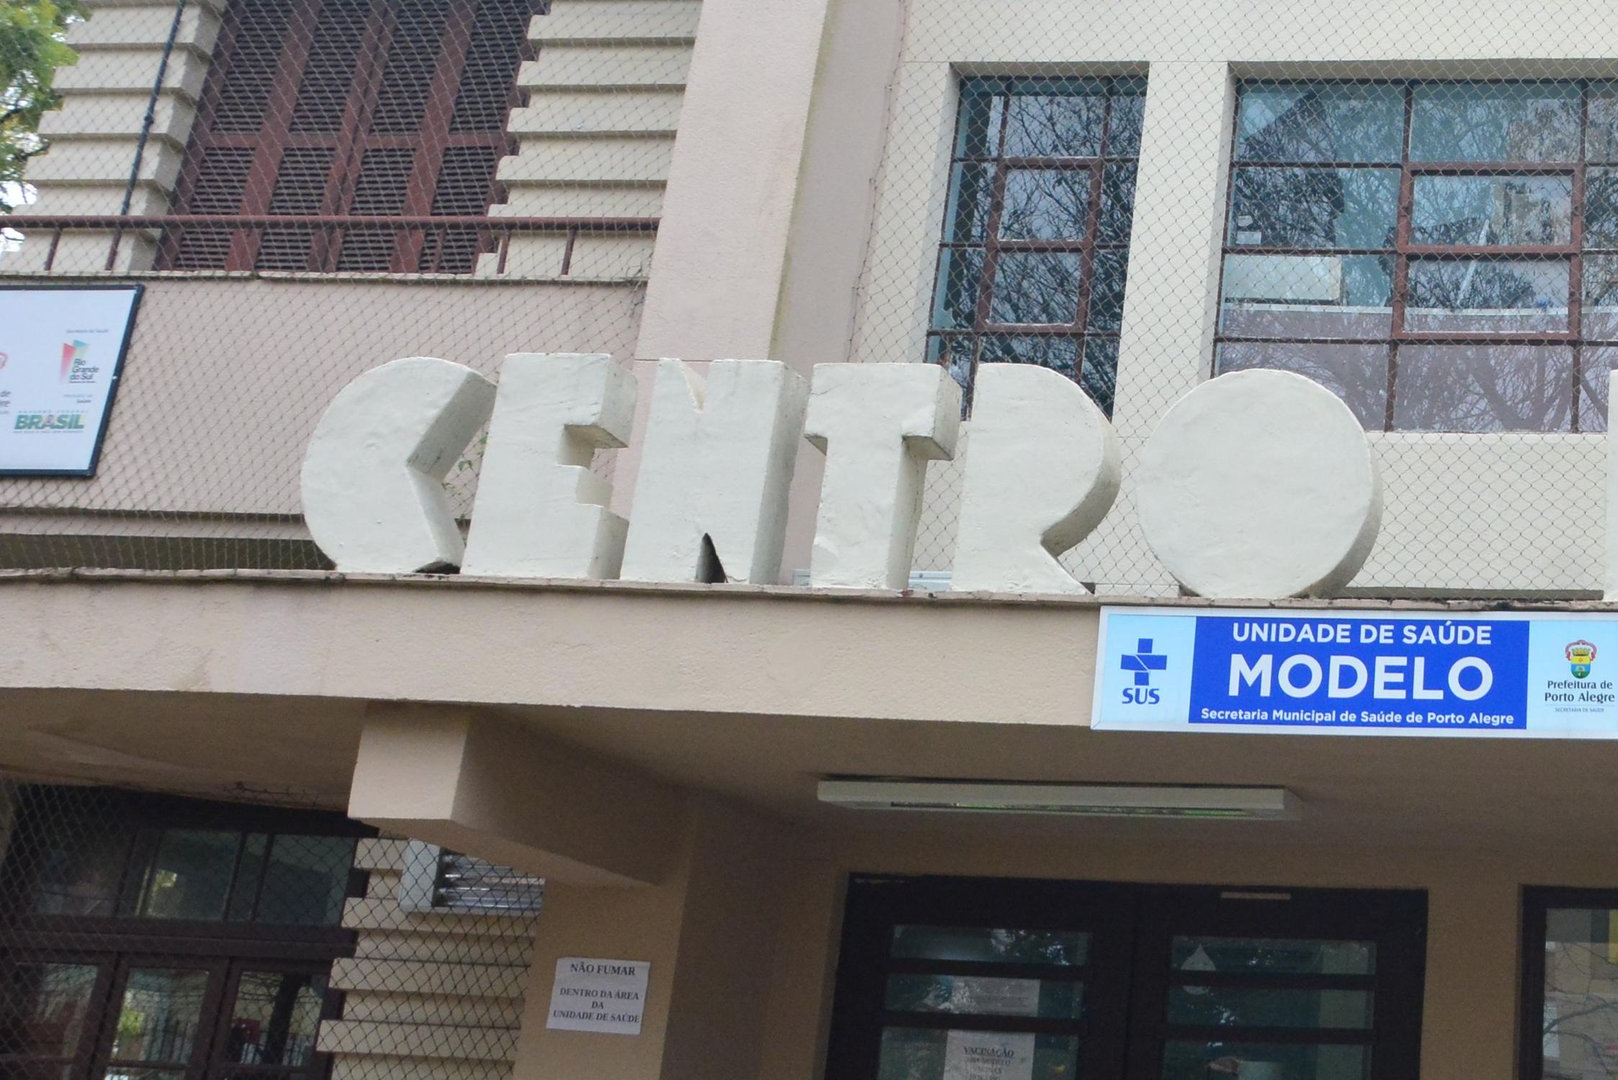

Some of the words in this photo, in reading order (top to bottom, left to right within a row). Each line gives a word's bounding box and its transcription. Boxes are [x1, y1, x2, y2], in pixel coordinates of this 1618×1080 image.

[14, 414, 84, 430] BRASIL
[300, 352, 1383, 600] CENTRO
[1232, 622, 1351, 643] UNIDADE
[1359, 624, 1394, 644] DE
[1402, 620, 1492, 645] SAÚDE
[1228, 653, 1493, 701] MODELO
[1547, 680, 1597, 689] Prefeitura
[1600, 680, 1613, 689] de
[1121, 687, 1160, 705] SUS
[1544, 692, 1574, 702] Porto
[1578, 691, 1615, 703] Alegre
[1201, 708, 1268, 721] Secretaria
[1272, 709, 1335, 724] Municipal
[1339, 710, 1356, 722] de
[1361, 710, 1402, 723] Saúde
[1406, 711, 1423, 723] de
[1427, 712, 1465, 724] Porto
[1468, 712, 1514, 726] Alegre
[570, 961, 595, 974] NÃO
[597, 965, 636, 976] FUMAR
[560, 987, 598, 998] DENTRO
[599, 989, 613, 999] DA
[613, 988, 640, 1000] ÁREA
[591, 1000, 604, 1010] DA
[553, 1009, 594, 1021] UNIDADE
[596, 1012, 609, 1021] DE
[610, 1012, 640, 1024] SAÚDE
